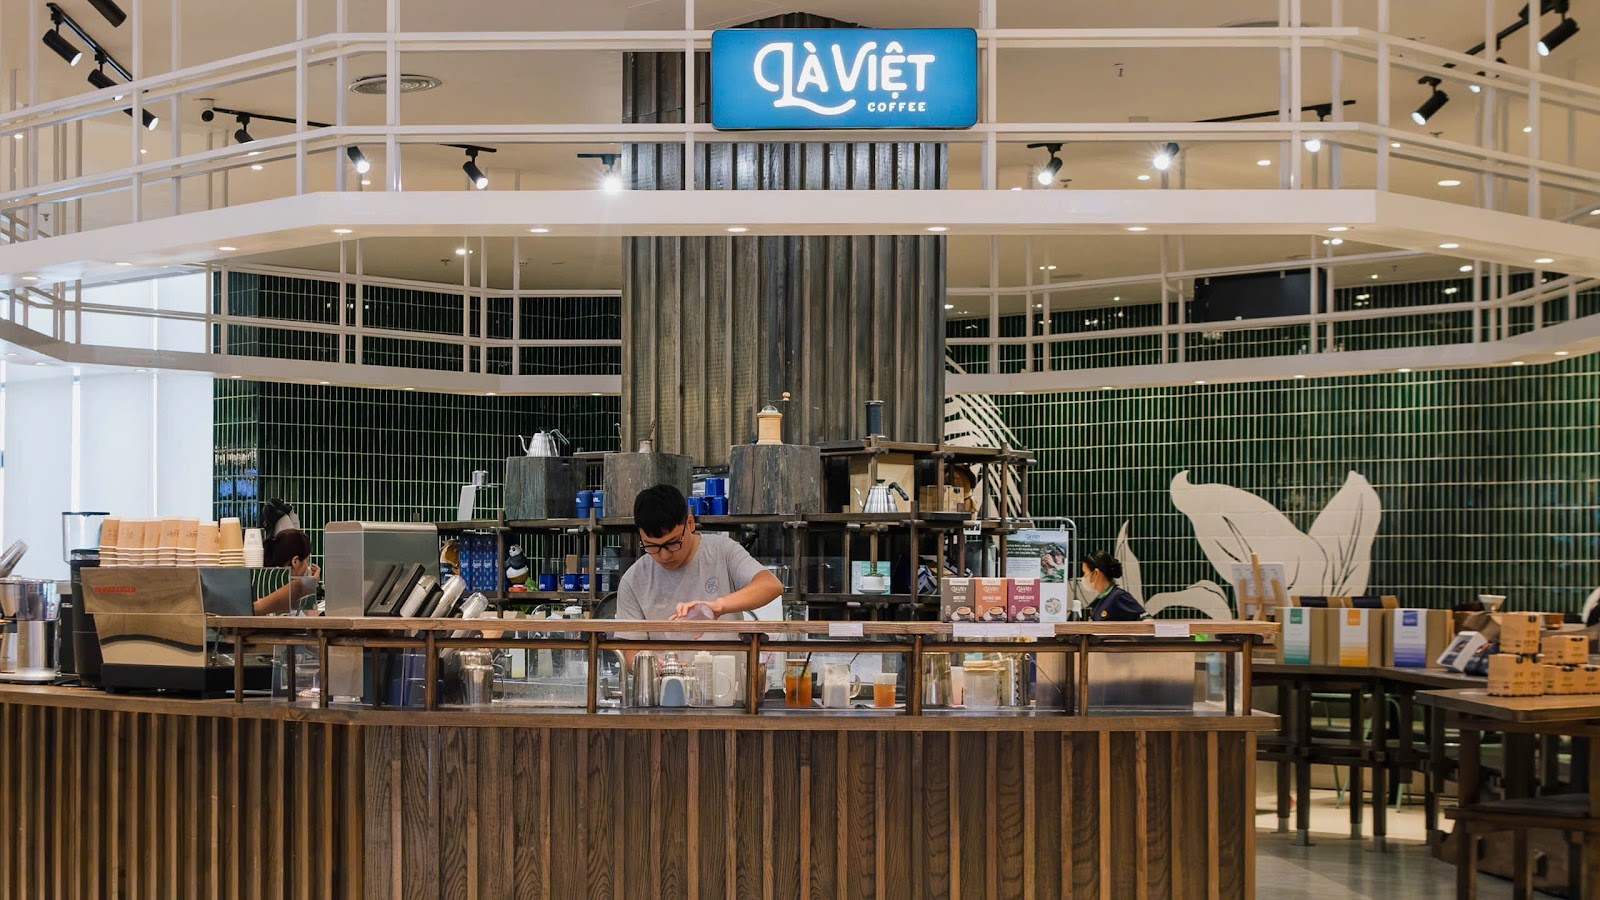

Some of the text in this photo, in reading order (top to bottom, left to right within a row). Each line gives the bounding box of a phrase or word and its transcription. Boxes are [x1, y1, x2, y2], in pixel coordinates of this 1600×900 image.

[753, 41, 936, 115] LÀ VIỆT
[867, 101, 927, 113] COFFEE
